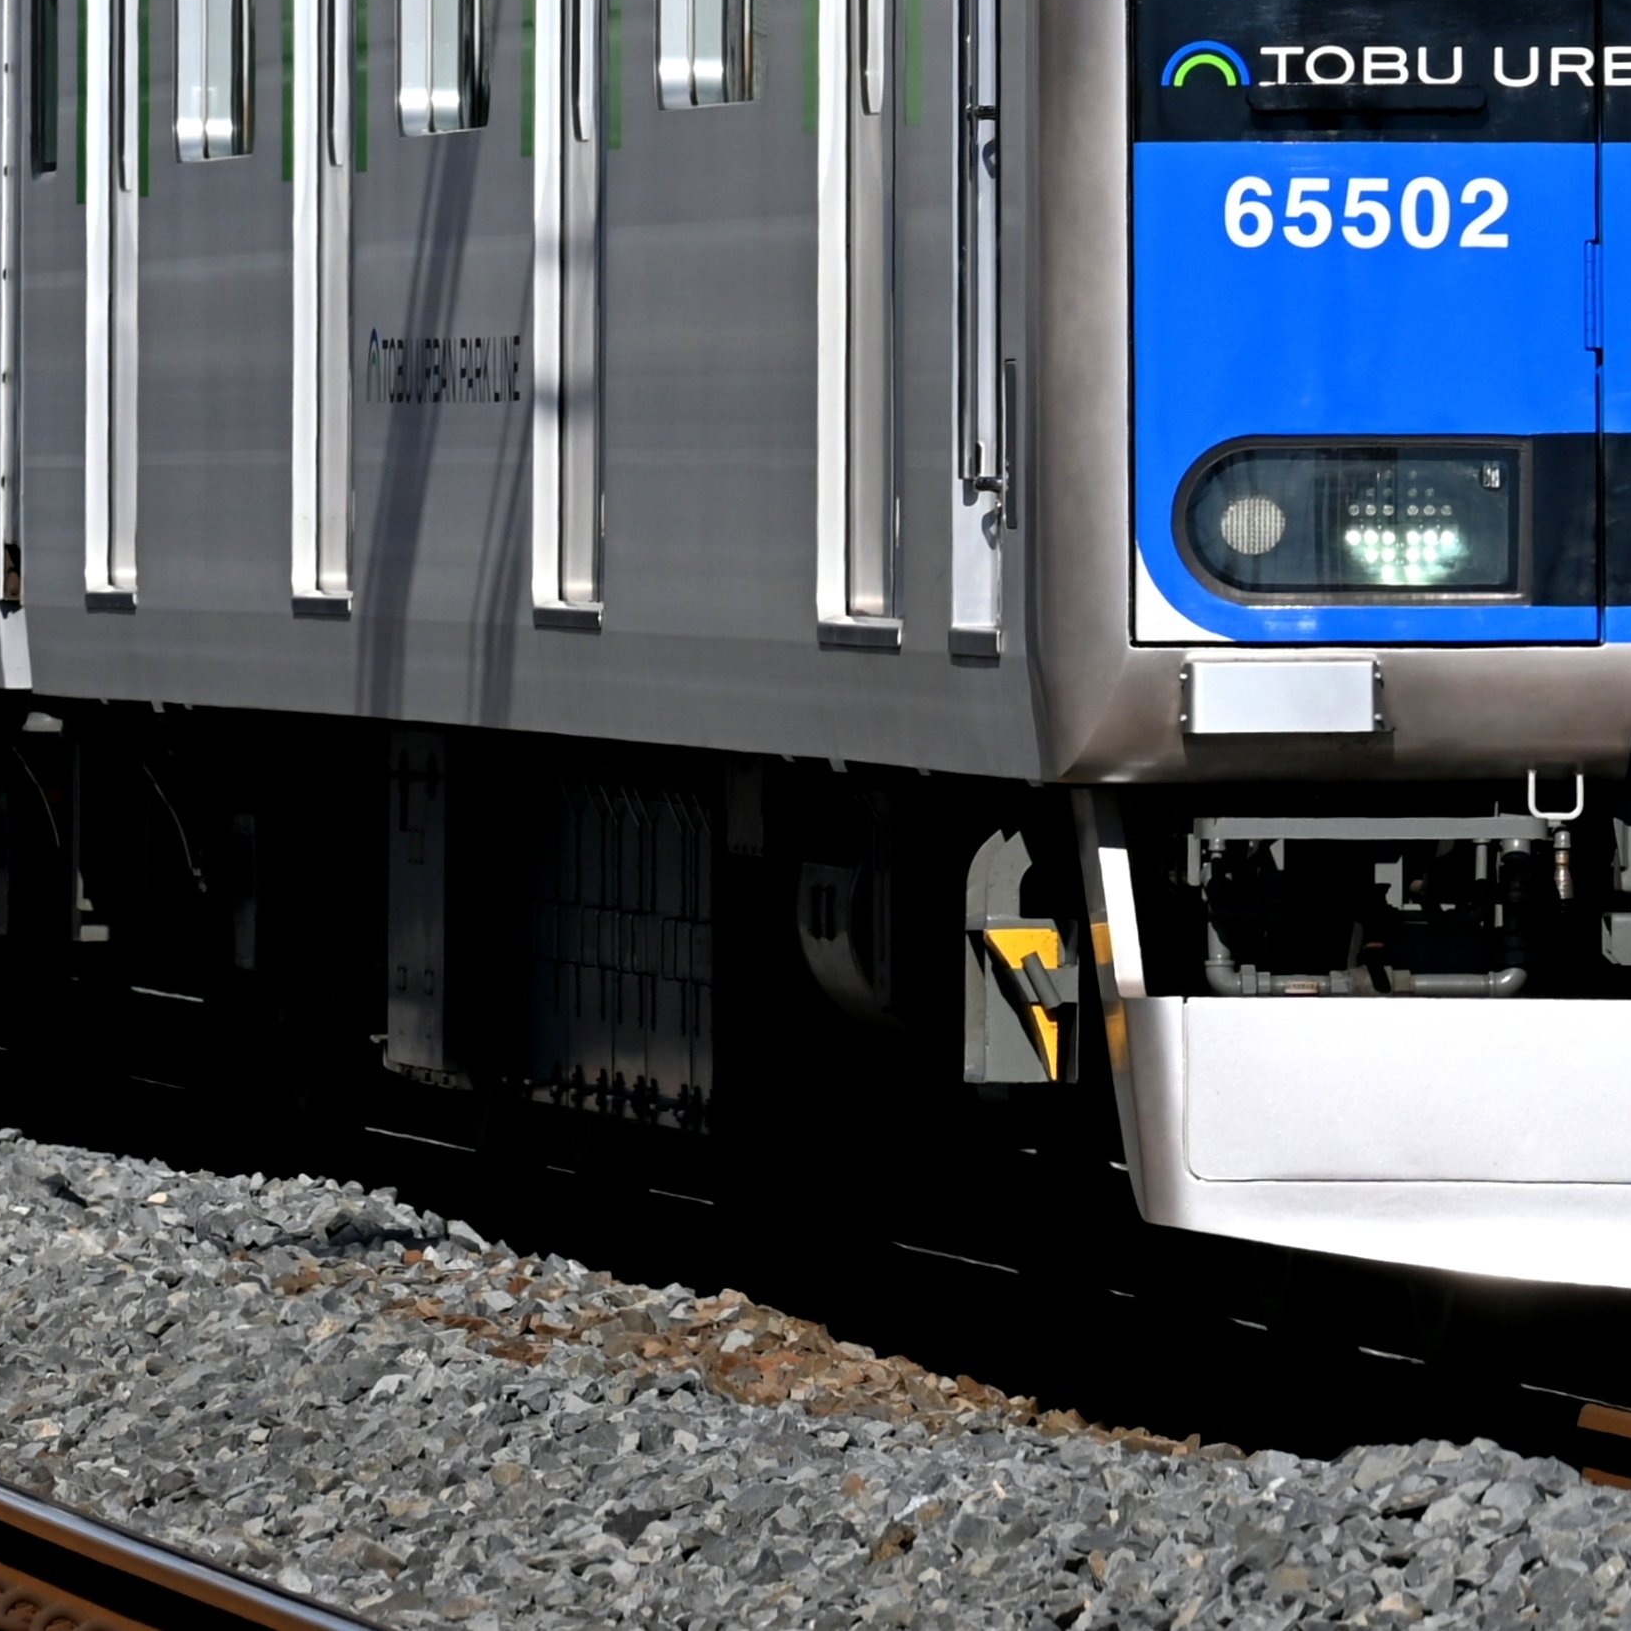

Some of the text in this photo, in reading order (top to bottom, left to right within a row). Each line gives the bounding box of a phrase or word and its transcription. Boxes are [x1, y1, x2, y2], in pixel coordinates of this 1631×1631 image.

[1258, 45, 1463, 87] TOBU
[1224, 176, 1510, 250] 65502
[381, 335, 521, 404] TOBU URBAN PARK LINE
